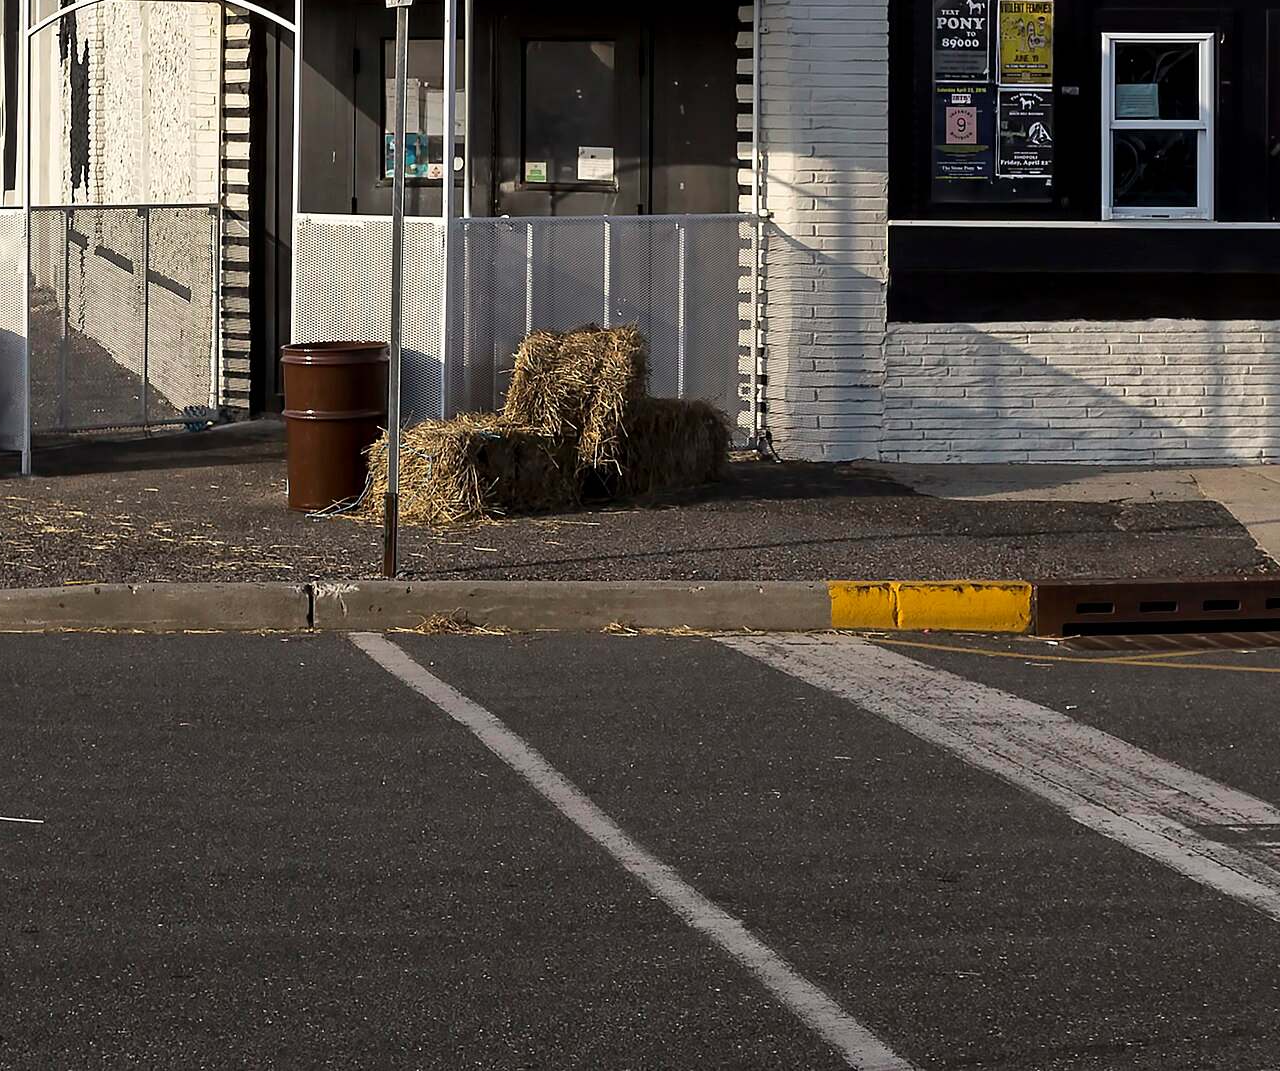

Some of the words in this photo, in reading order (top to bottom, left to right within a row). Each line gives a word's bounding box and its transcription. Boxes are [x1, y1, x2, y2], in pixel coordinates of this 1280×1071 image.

[936, 17, 986, 30] PONY
[941, 37, 980, 49] 89000
[956, 117, 967, 133] 9
